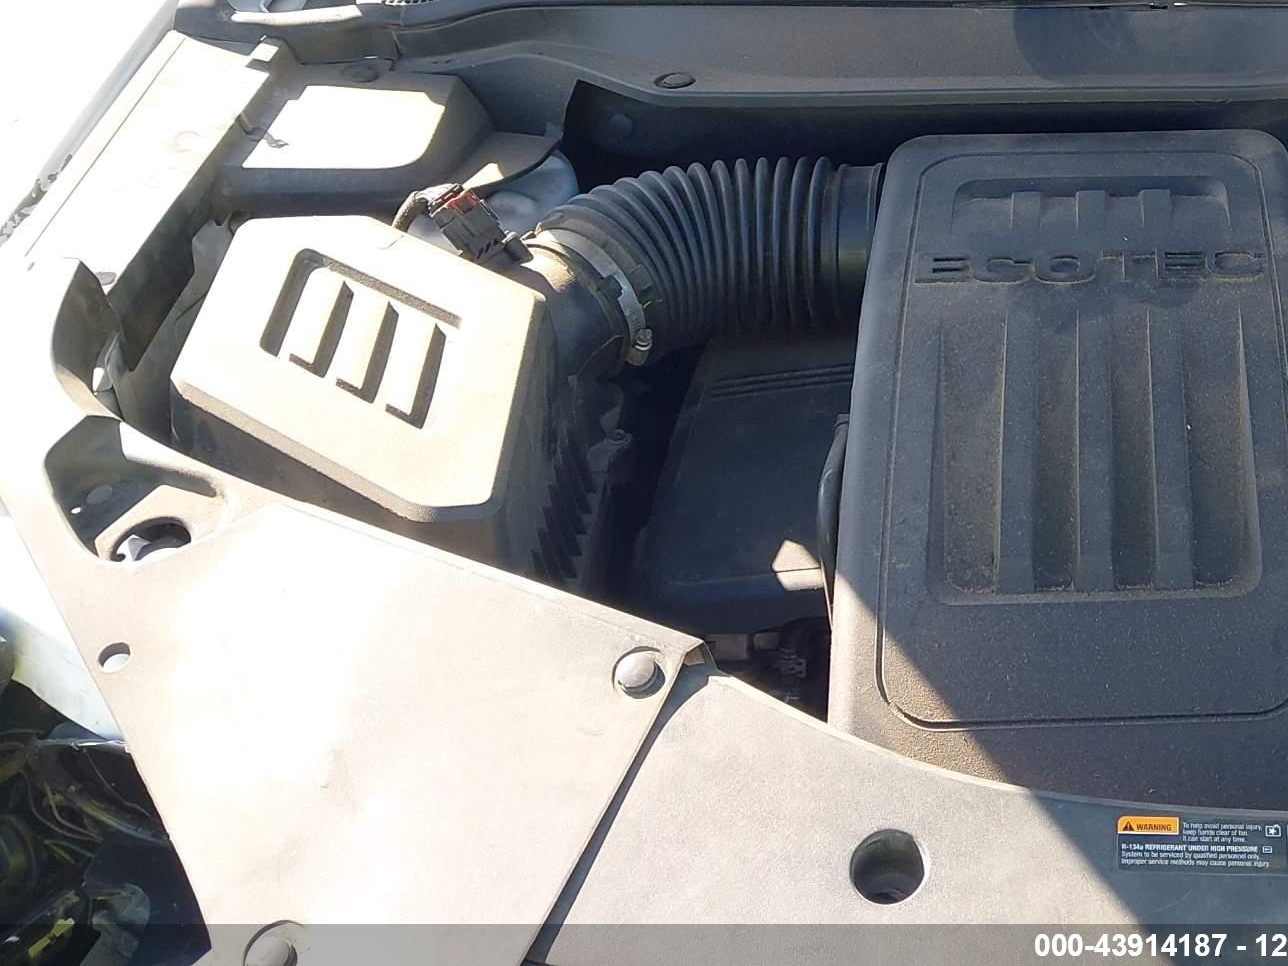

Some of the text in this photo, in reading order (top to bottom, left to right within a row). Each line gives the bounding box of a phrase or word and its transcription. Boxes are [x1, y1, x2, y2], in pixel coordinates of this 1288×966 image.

[914, 250, 1265, 283] ECOTEC
[1136, 823, 1172, 832] WARNING
[1121, 843, 1144, 851] R-134a
[1144, 844, 1187, 852] REFRIGERANT
[1210, 845, 1226, 853] HIGH
[1121, 850, 1143, 858] System
[1184, 852, 1192, 860] by
[1193, 852, 1218, 861] qualified
[1218, 853, 1247, 861] personnel
[1195, 860, 1209, 868] may
[1227, 861, 1253, 869] personal
